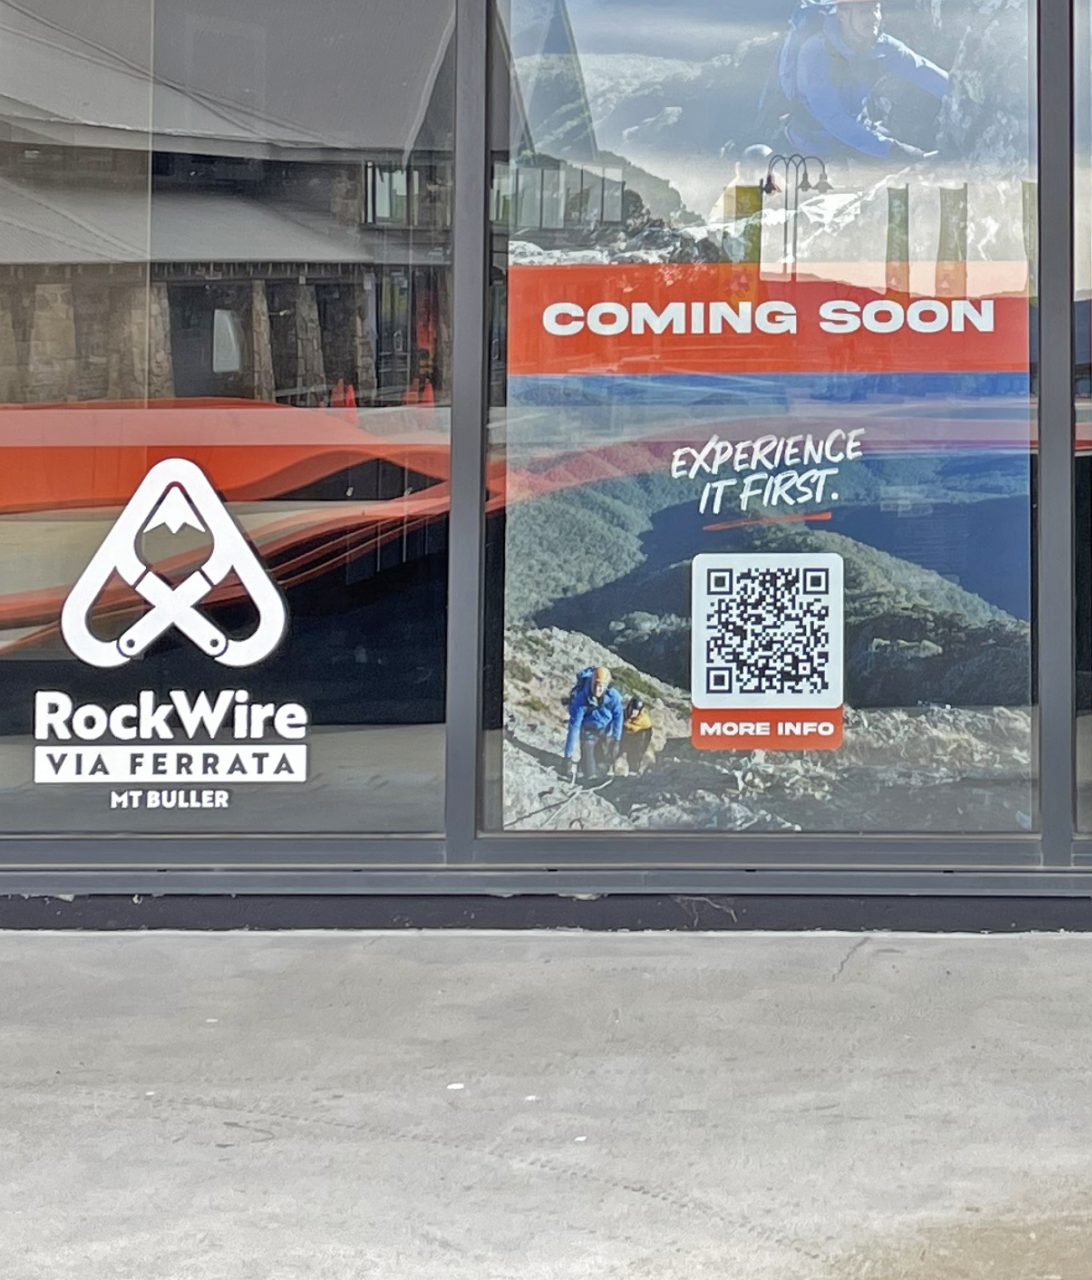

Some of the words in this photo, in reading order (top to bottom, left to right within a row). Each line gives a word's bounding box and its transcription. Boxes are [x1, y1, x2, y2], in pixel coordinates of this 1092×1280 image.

[542, 301, 797, 335] COMING
[819, 299, 995, 333] SOON
[671, 428, 866, 479] EXPERIENCE
[699, 478, 737, 514] IT
[740, 467, 839, 511] FIRST.
[34, 689, 307, 740] RockWire
[699, 721, 769, 736] MORE
[778, 721, 834, 736] INFO
[46, 753, 110, 775] VIA
[130, 752, 294, 775] FERRATA
[110, 791, 144, 808] MT
[147, 791, 229, 808] BULLER
